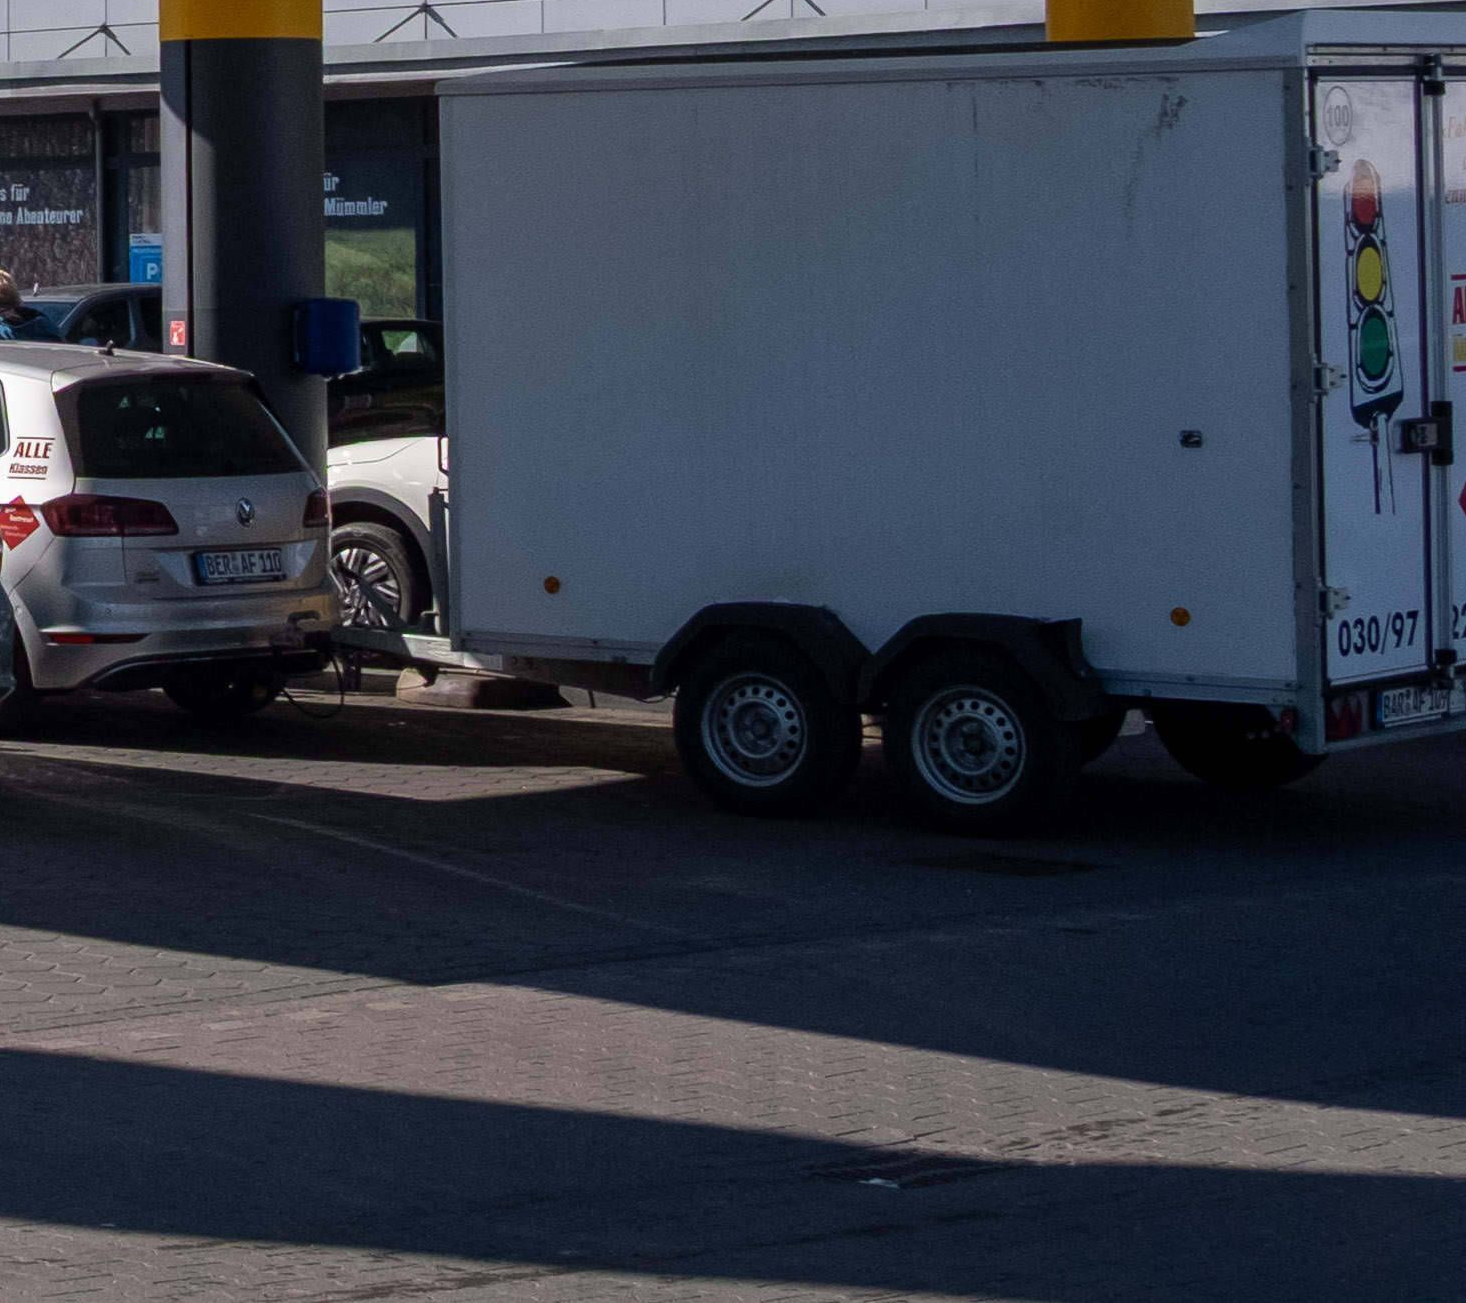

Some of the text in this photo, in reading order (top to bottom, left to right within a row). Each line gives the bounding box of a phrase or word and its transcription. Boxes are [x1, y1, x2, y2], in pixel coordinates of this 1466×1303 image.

[1327, 104, 1350, 128] 100
[11, 183, 30, 202] für
[17, 206, 84, 225] Abenteurer
[13, 442, 54, 459] ALLE
[9, 463, 48, 475] Klassen
[1338, 609, 1420, 657] 030/97
